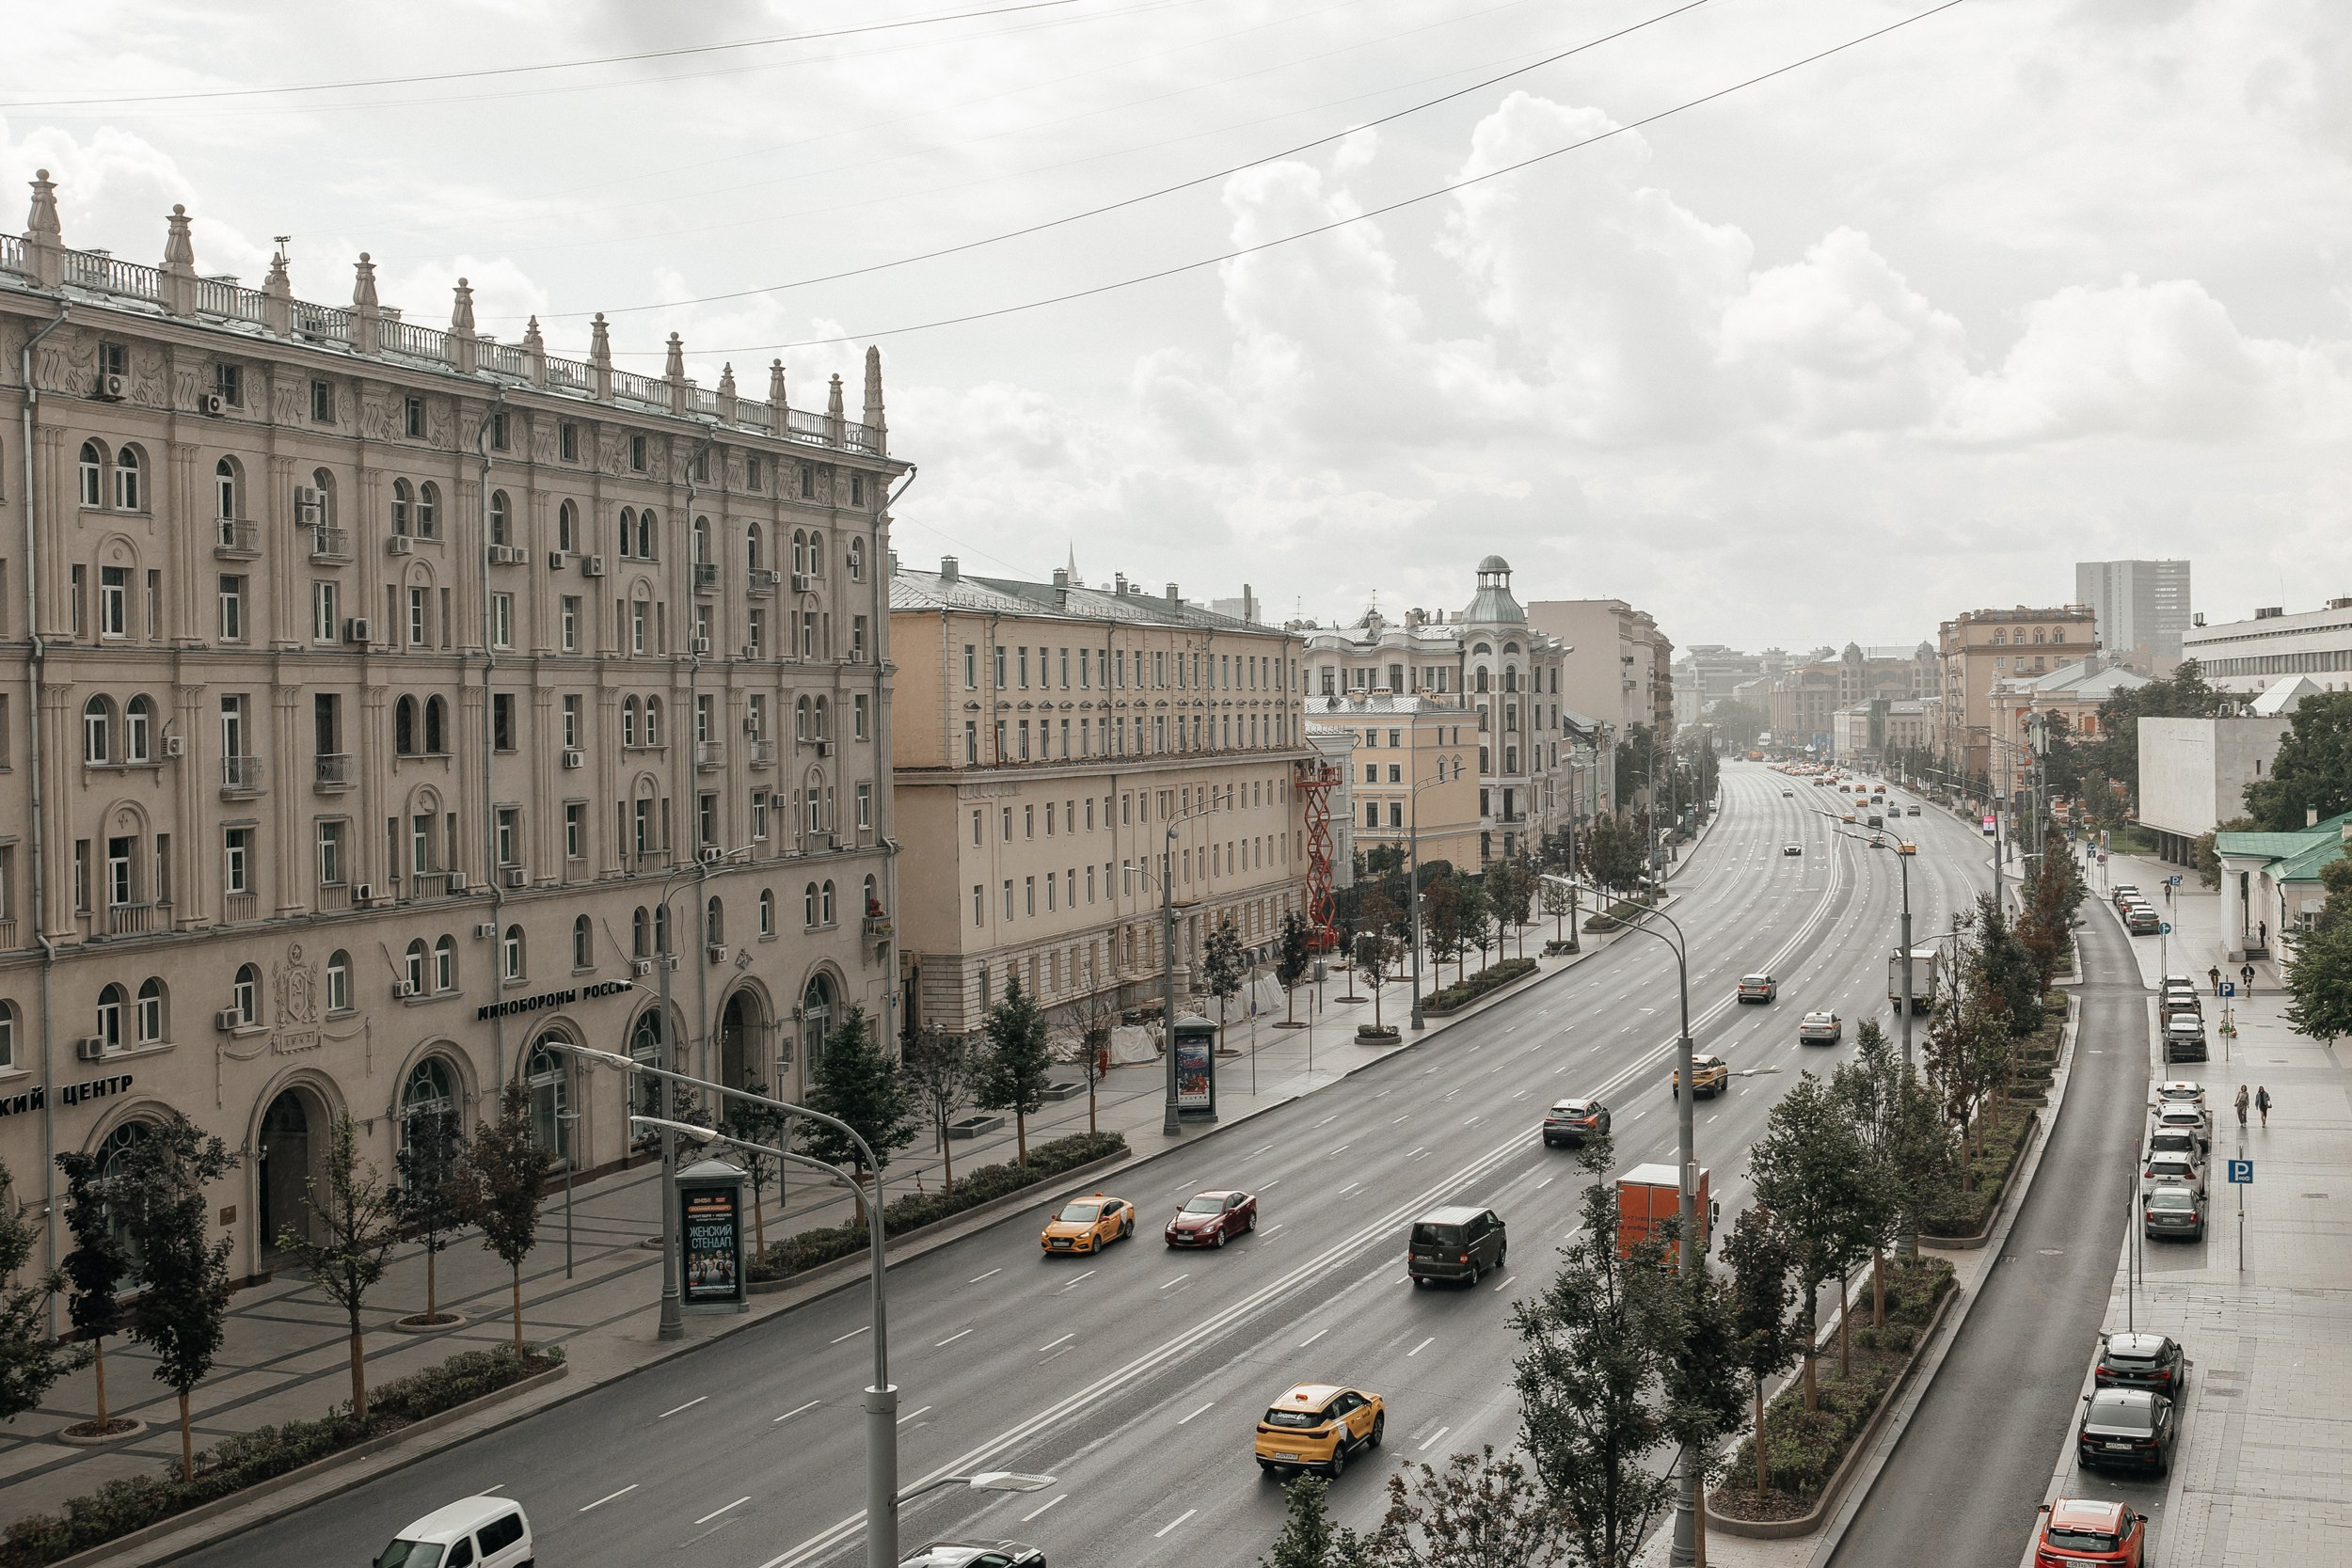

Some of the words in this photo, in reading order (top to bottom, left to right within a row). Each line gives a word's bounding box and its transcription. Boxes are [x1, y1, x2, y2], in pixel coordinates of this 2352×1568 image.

[2222, 983, 2232, 996] P
[477, 988, 576, 1021] МИНОБОРОНЫ
[62, 1073, 134, 1106] ЦЕНТР
[2234, 1162, 2249, 1181] P
[690, 1225, 732, 1237] ЖЕНСКИЙ
[691, 1237, 731, 1248] СТЕНДАП
